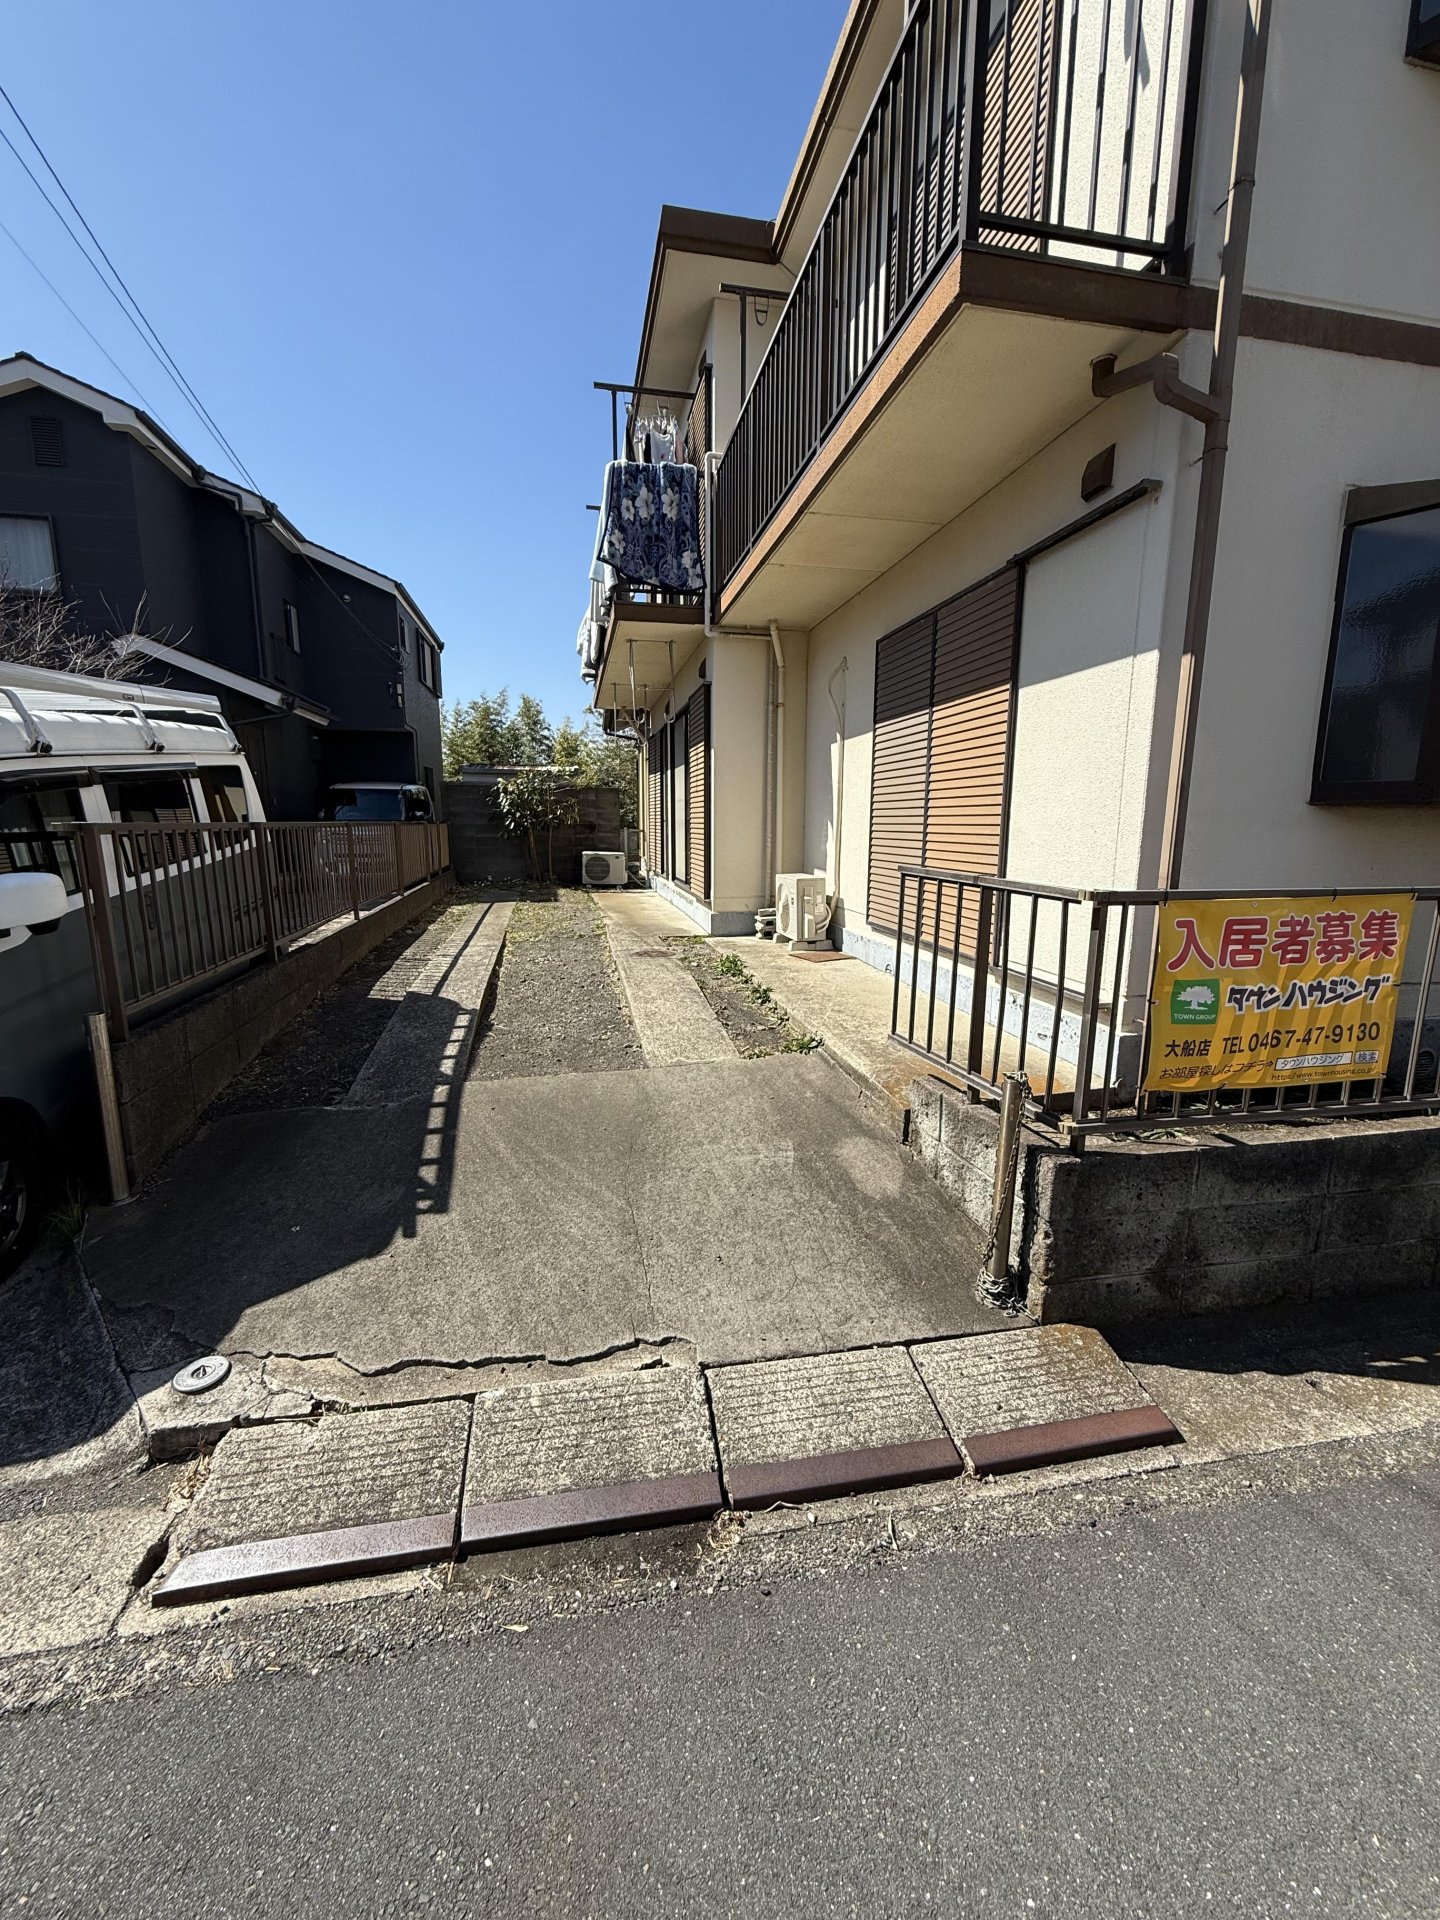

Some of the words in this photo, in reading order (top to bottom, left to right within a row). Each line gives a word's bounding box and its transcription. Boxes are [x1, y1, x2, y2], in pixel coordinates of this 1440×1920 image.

[1166, 909, 1400, 972] 入居者募集
[1226, 975, 1392, 1013] タウンハウジング
[1164, 1038, 1212, 1058] 大船店
[1222, 1036, 1245, 1055] TEL
[1248, 1021, 1381, 1053] 0467-47-9130
[1159, 1060, 1266, 1080] お部屋探しはコチラ
[1280, 1054, 1345, 1069] タウンハウジング
[1357, 1052, 1377, 1062] 検索
